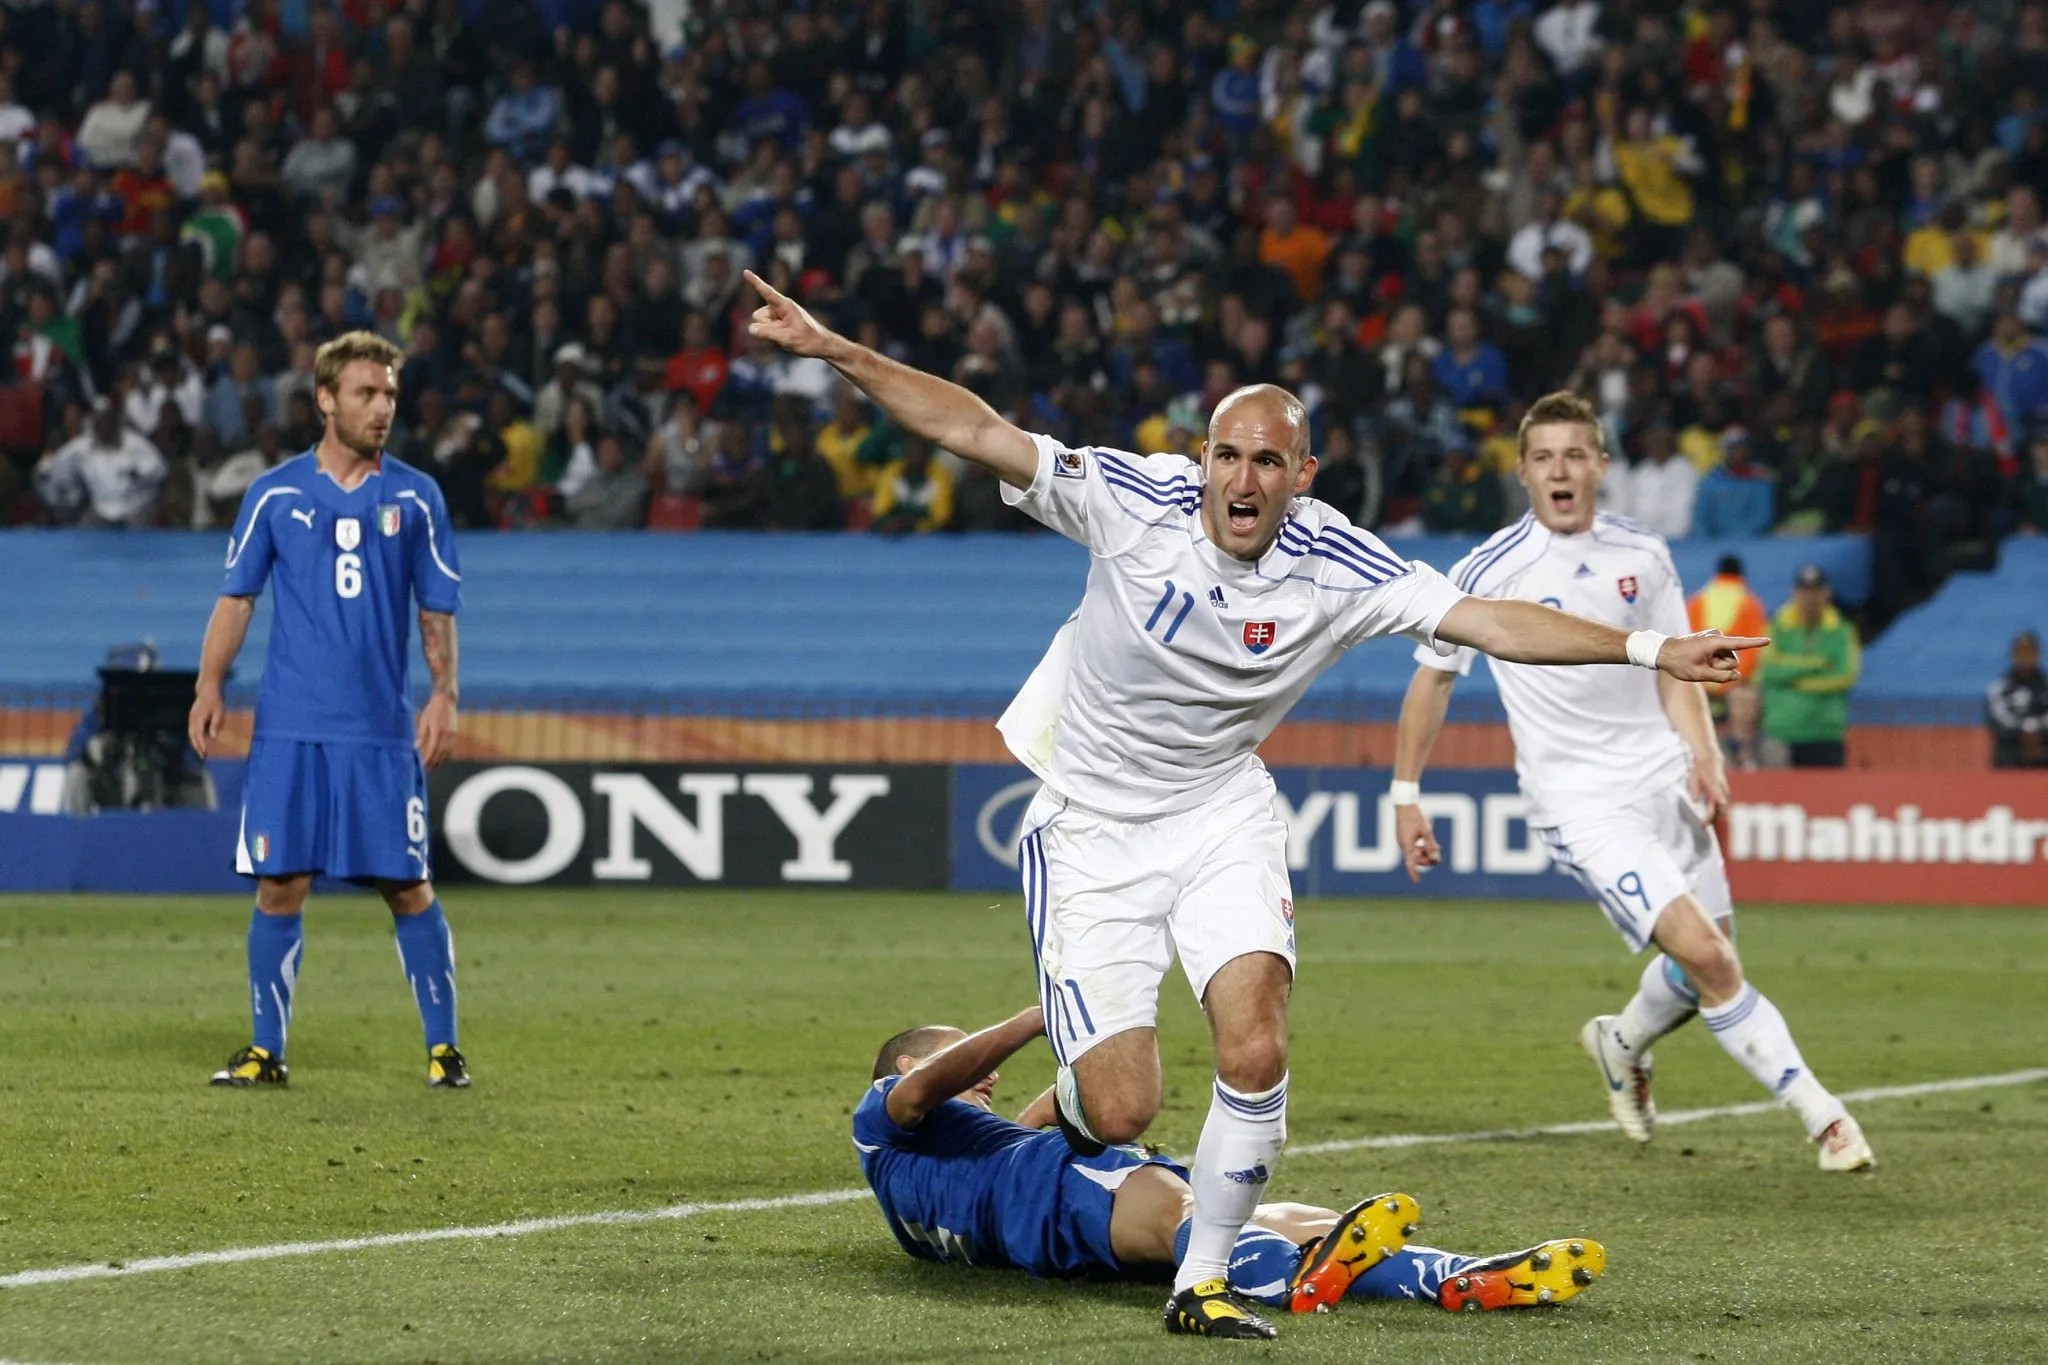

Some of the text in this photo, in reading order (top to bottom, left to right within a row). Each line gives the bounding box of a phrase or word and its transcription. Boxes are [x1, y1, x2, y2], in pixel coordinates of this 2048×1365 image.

[335, 553, 362, 598] 6
[1144, 579, 1195, 643] 11
[406, 796, 425, 843] 6
[443, 765, 889, 884] ONY
[1274, 792, 1572, 875] YUND
[1728, 802, 2048, 863] Mahindr
[1605, 871, 1651, 922] 19
[1055, 979, 1096, 1041] 11
